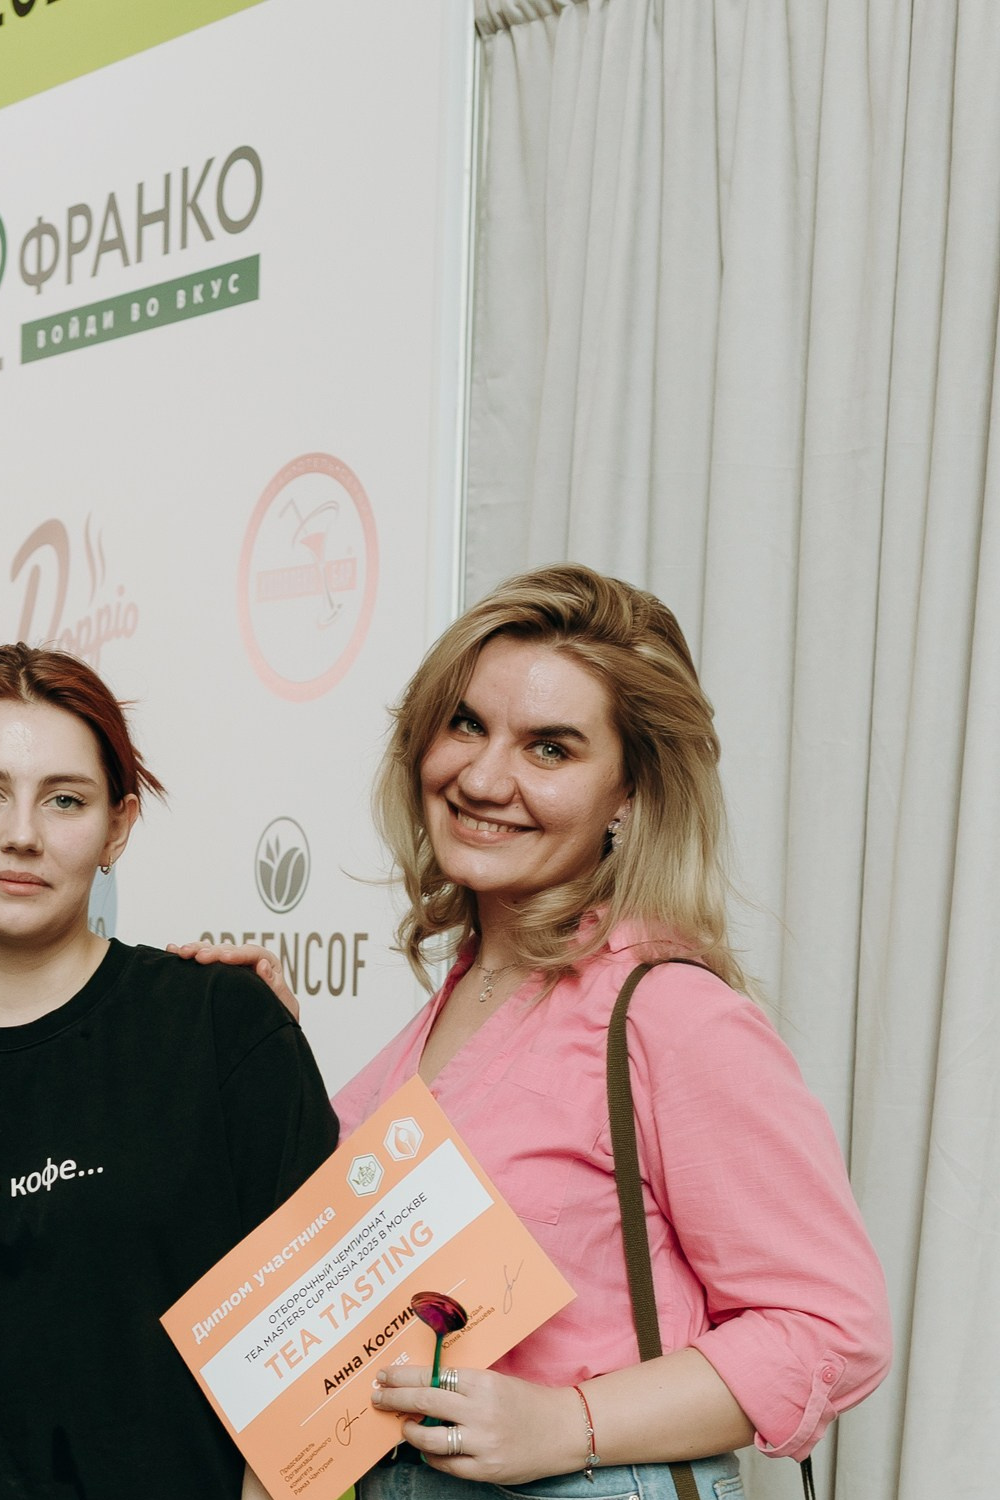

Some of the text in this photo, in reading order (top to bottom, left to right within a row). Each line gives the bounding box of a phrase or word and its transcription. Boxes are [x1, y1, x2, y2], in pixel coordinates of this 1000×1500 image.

[19, 145, 263, 295] ФРАНКО
[36, 273, 240, 349] ВОЙДИ ВО ВКУС
[200, 931, 369, 997] NCOF
[10, 1157, 104, 1198] кофе...
[192, 1207, 334, 1343] Диплом участника
[244, 1345, 264, 1362] TEA
[263, 1306, 305, 1346] MASTERS
[306, 1288, 324, 1308] CUP
[325, 1260, 357, 1291] RUSSIA
[357, 1236, 378, 1261] 2025
[386, 1192, 426, 1231] МОСКВЕ
[264, 1221, 432, 1378] TEA TASTING
[268, 1210, 385, 1323] ОТБОРОЧНЫЙ ЧЕМПИОНАТ
[455, 1307, 493, 1338] Малышева
[324, 1356, 362, 1394] Анна
[279, 1443, 314, 1475] Председатель
[282, 1437, 331, 1482] Организационного
